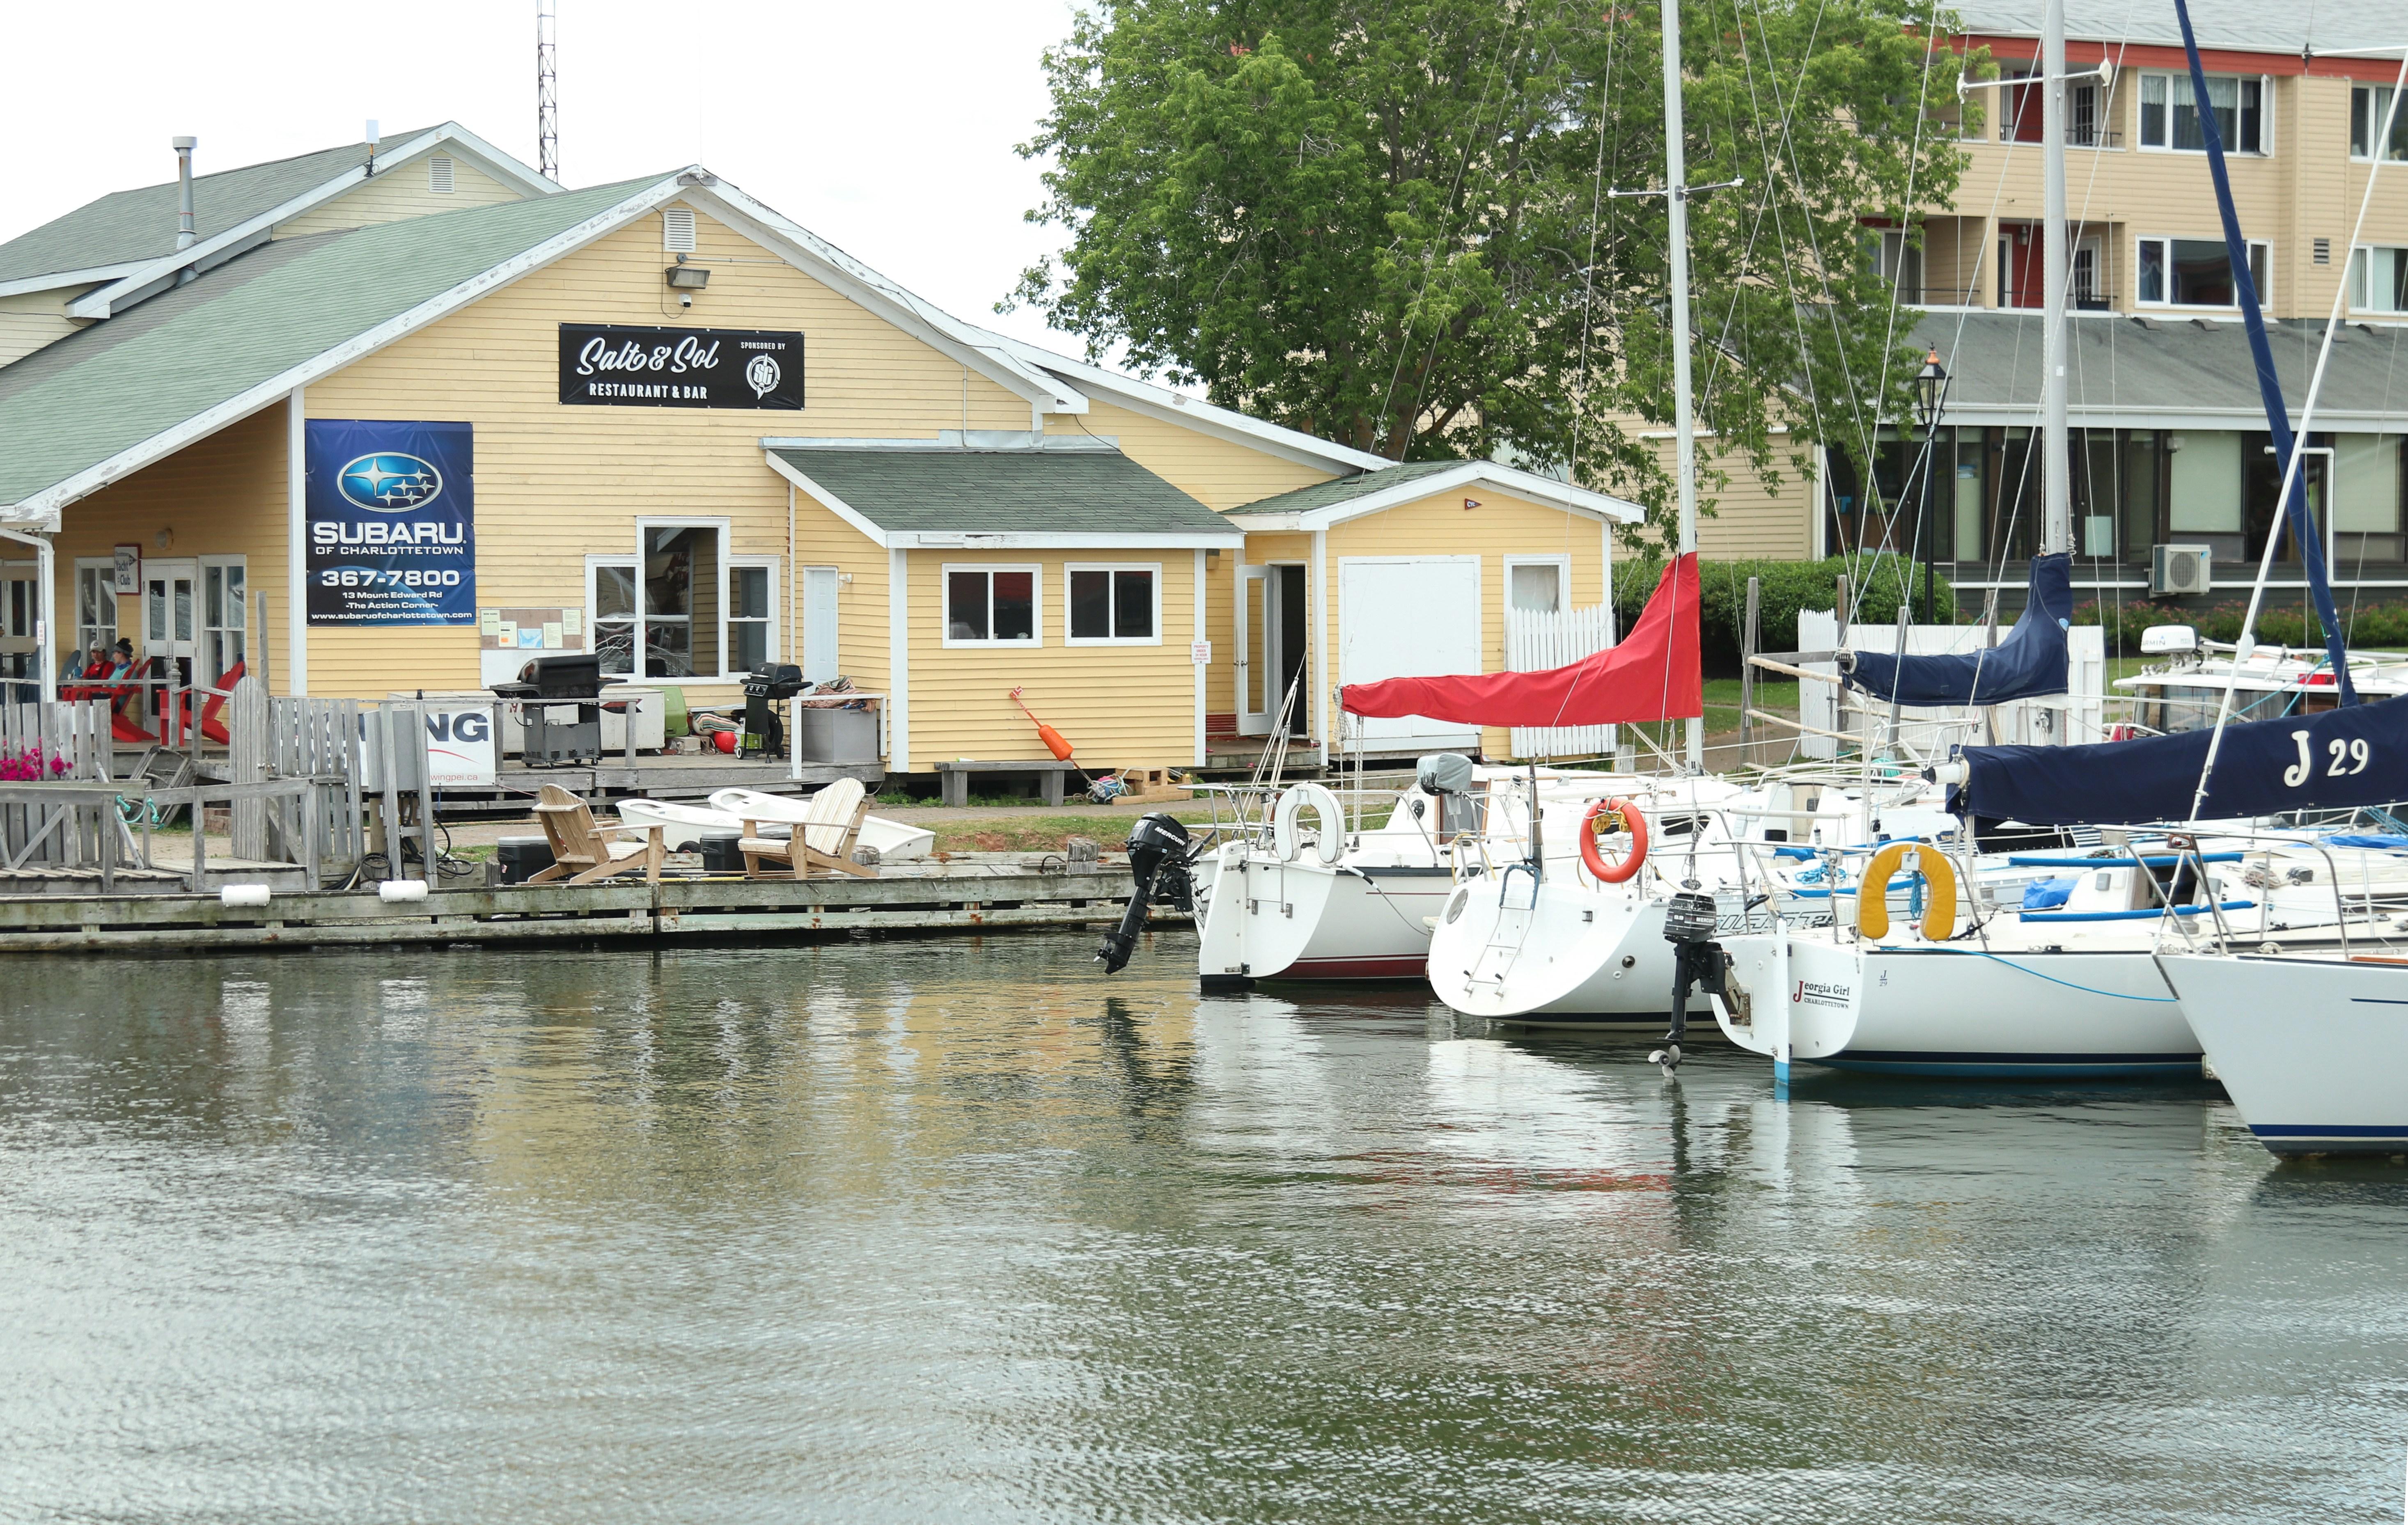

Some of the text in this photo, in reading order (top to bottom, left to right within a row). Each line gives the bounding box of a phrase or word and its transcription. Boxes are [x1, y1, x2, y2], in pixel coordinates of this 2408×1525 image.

[576, 336, 720, 376] Salt & Sol
[589, 383, 707, 399] RESTAURANT & BAR
[313, 522, 463, 544] SUBARU
[315, 546, 463, 555] OF CHARLOTTETOWN
[120, 574, 131, 585] Club
[322, 570, 460, 586] 367-7800
[2283, 730, 2369, 788] J 29
[431, 773, 478, 782] wingpei.ca
[1154, 826, 1186, 846] MERCURY
[1880, 970, 1887, 978] J
[1793, 980, 1850, 1003] Jeorgia Girl
[1804, 997, 1849, 1009] CHARLOTTETOWN
